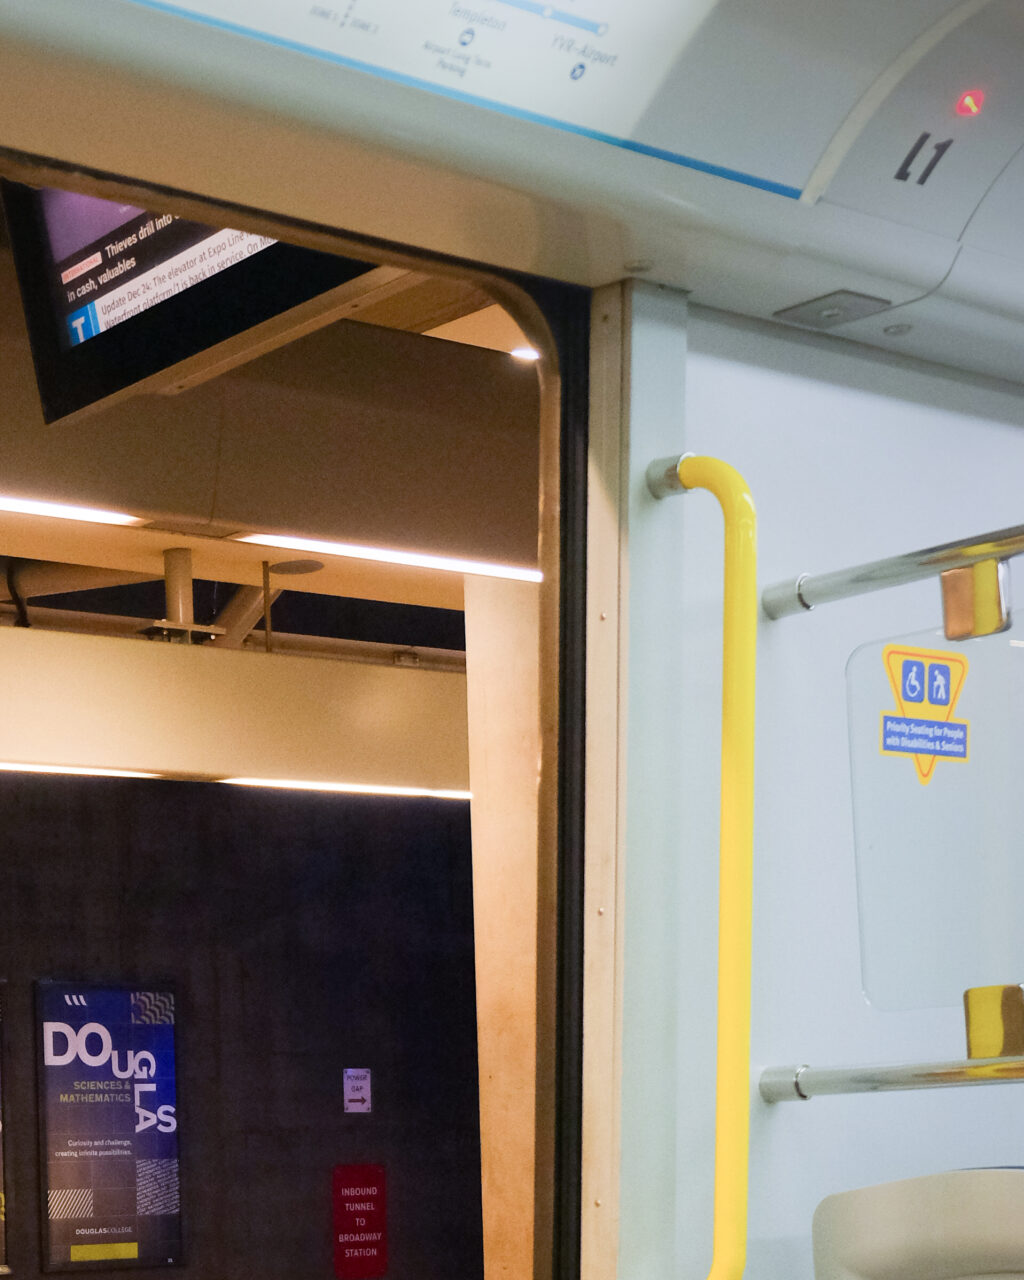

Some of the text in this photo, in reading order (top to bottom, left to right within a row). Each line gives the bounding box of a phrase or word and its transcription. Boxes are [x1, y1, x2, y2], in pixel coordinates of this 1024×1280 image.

[448, 1, 507, 31] Templeton
[551, 34, 618, 66] YVR-Airport
[105, 214, 173, 258] Thieves drill into
[188, 271, 208, 285] back
[208, 263, 217, 275] in
[247, 243, 259, 254] On
[102, 296, 126, 315] Update
[127, 291, 141, 302] Dec
[153, 276, 166, 287] The
[168, 258, 197, 280] elevator
[198, 251, 207, 263] at
[208, 242, 227, 259] Expo
[228, 231, 244, 248] Line
[67, 256, 136, 302] in cash, valuables
[886, 721, 964, 740] Priority Seating for People
[886, 736, 900, 746] with
[901, 736, 934, 750] Disabilities
[935, 741, 941, 750] &
[43, 1021, 177, 1133] DOUGLAS
[346, 1074, 368, 1082] POWER
[73, 1080, 131, 1090] SCIENCES &
[60, 1093, 131, 1103] MATHEMATICS
[68, 1139, 93, 1148] Curiosity
[93, 1138, 104, 1147] and
[55, 1150, 78, 1158] creating
[342, 1187, 377, 1196] INBOUND
[345, 1203, 375, 1211] TUNNEL
[355, 1218, 366, 1226] TO
[338, 1232, 382, 1242] BROADWAY
[345, 1248, 377, 1257] STATION
